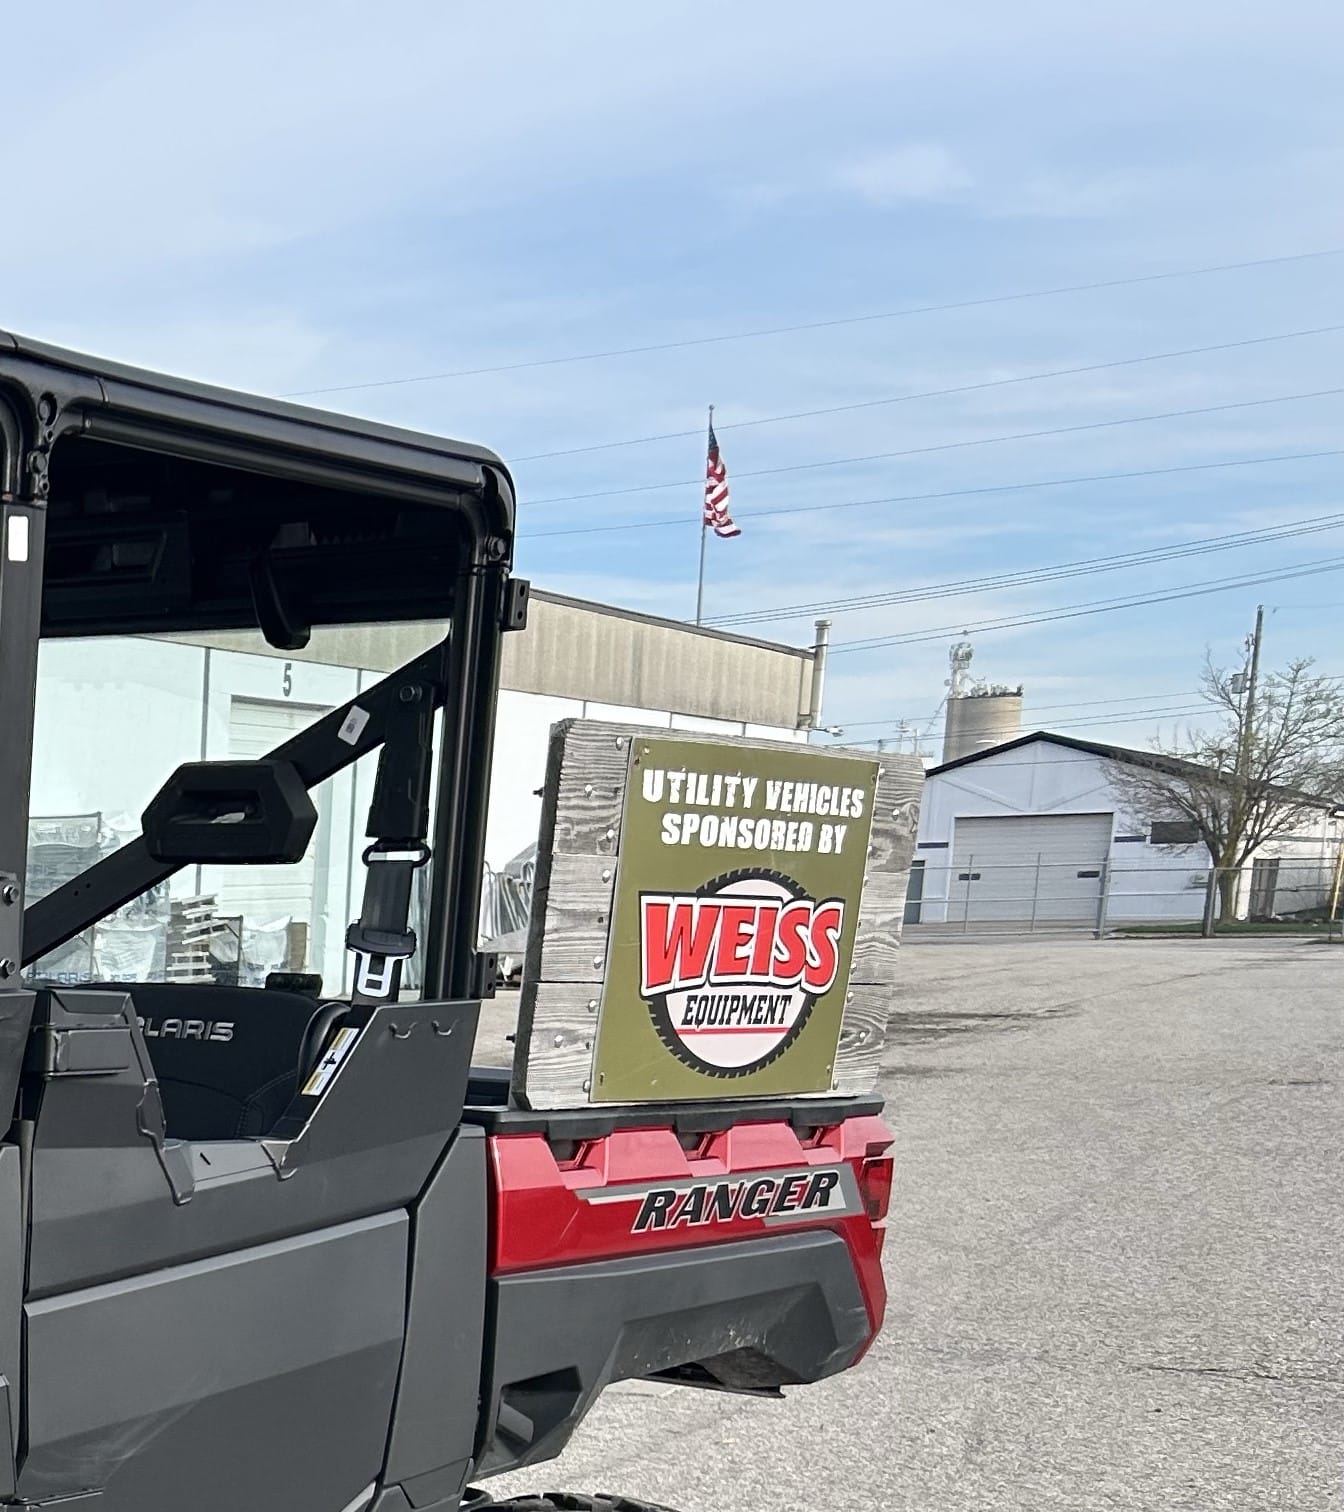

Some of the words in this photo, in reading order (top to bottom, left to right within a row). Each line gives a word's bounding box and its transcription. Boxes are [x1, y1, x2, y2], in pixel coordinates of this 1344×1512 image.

[282, 662, 292, 697] 5
[642, 768, 759, 809] UTILITY
[765, 780, 865, 819] VEHICLES
[661, 812, 814, 852] SPONSORED
[817, 823, 848, 855] BY
[642, 900, 843, 991] WEISS
[135, 1015, 235, 1042] LARIS
[680, 994, 793, 1028] EQUIPMENT
[631, 1169, 841, 1234] RANGER
